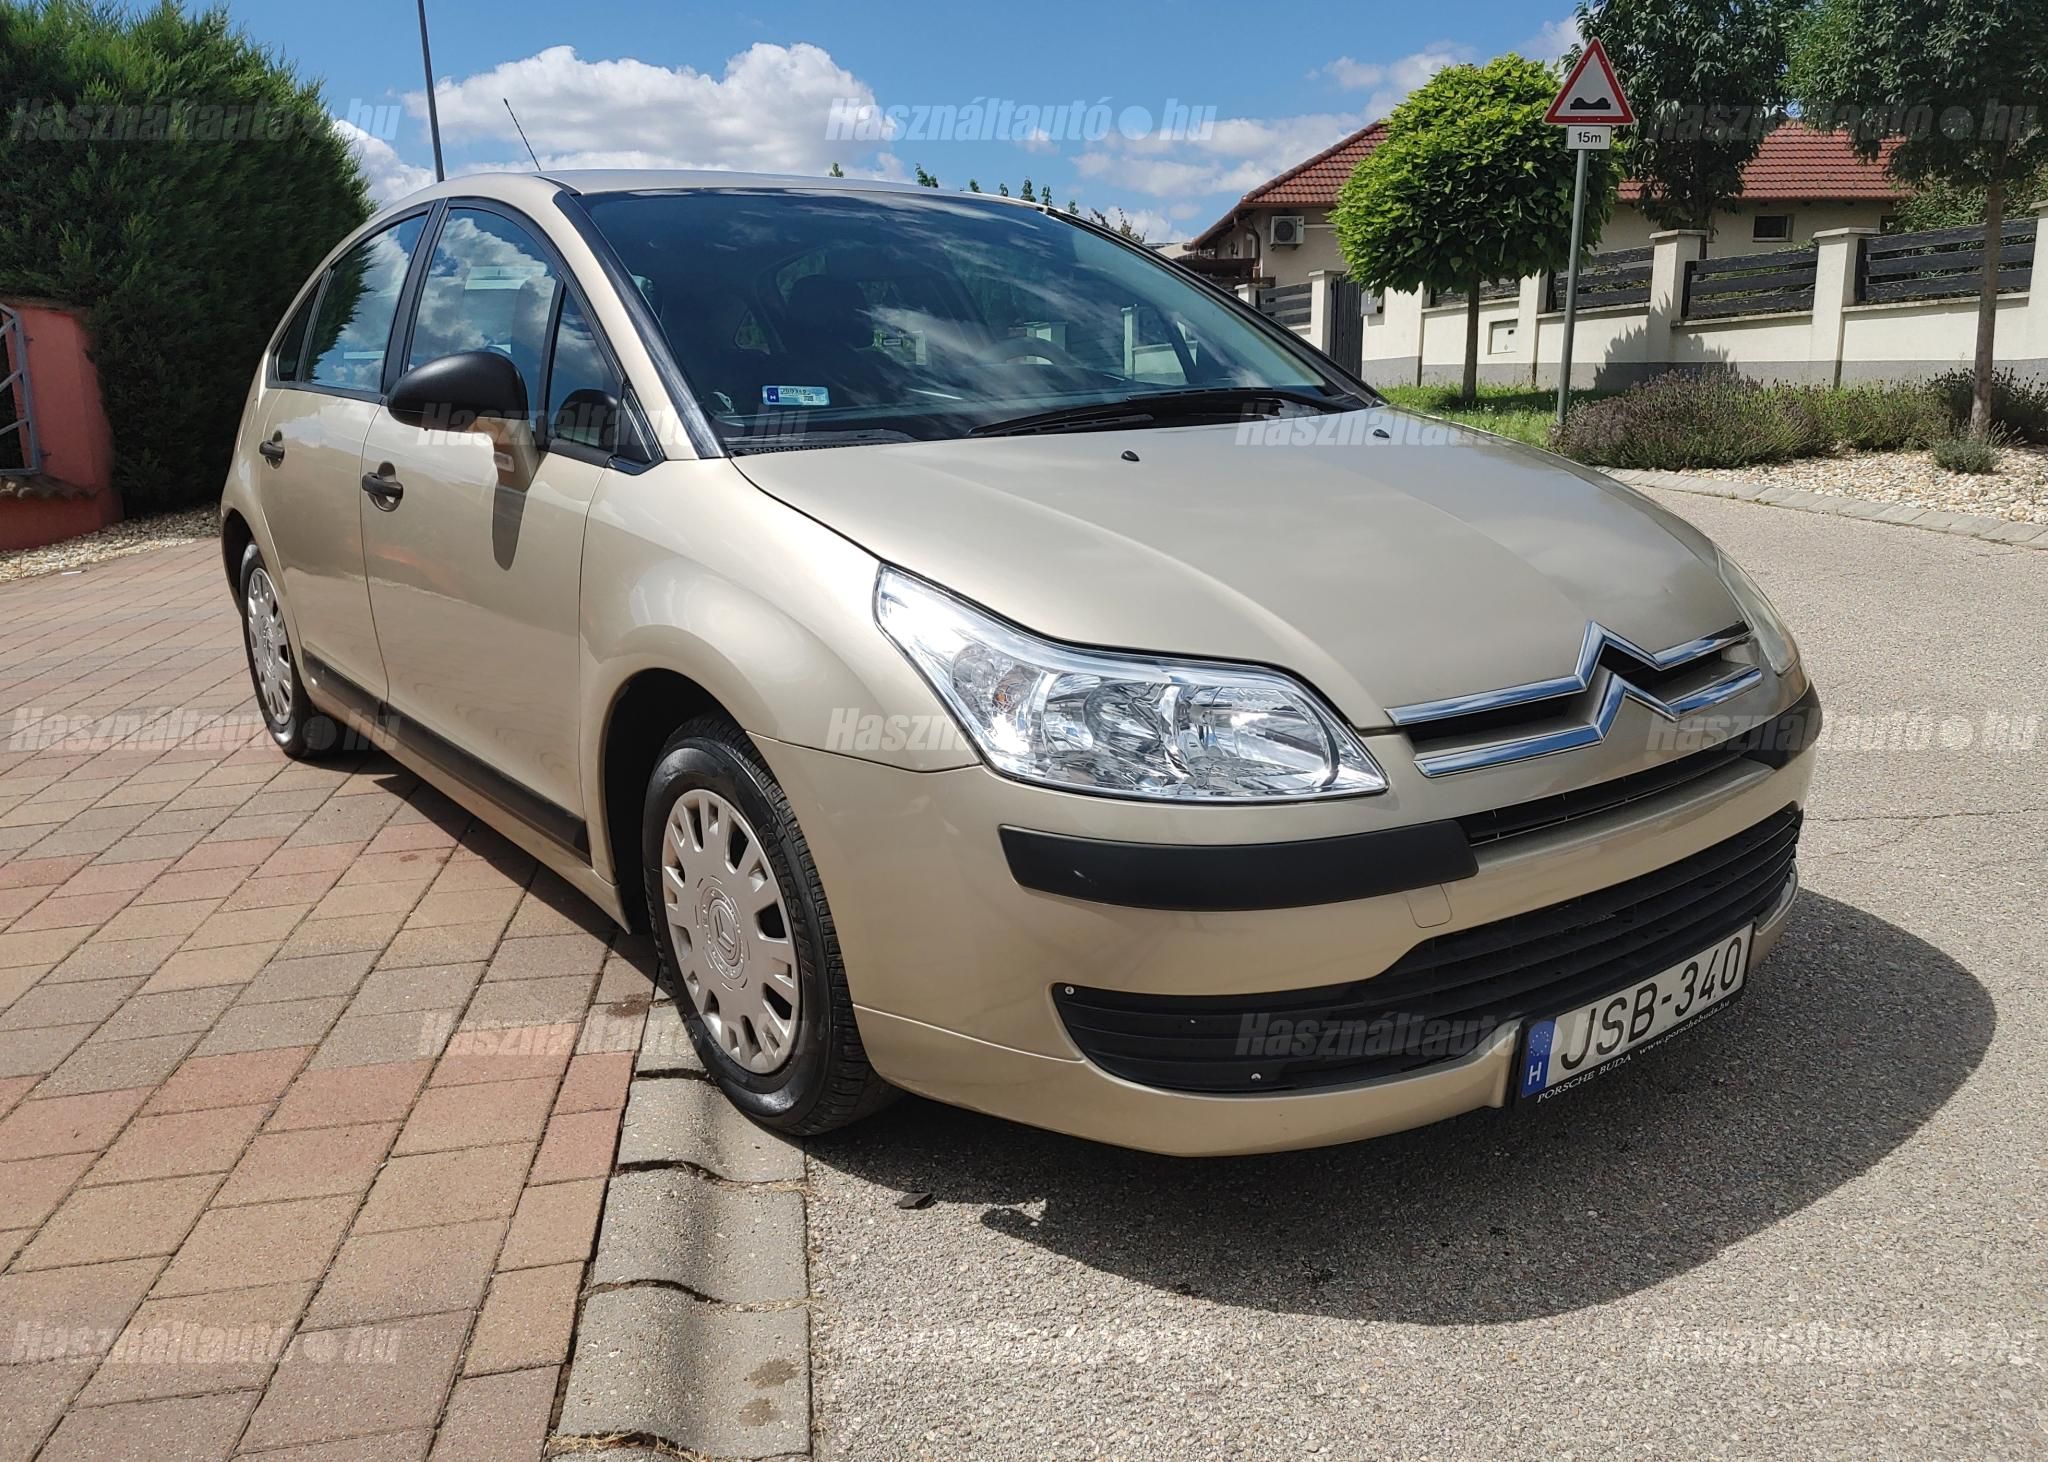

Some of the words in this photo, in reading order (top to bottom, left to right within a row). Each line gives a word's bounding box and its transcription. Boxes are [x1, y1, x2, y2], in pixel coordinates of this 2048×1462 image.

[1577, 131, 1602, 143] 15m
[1560, 936, 1742, 1070] JSB-340
[1528, 1061, 1543, 1086] H
[1536, 1070, 1597, 1104] PORSCHE
[1598, 1053, 1632, 1076] BUDA
